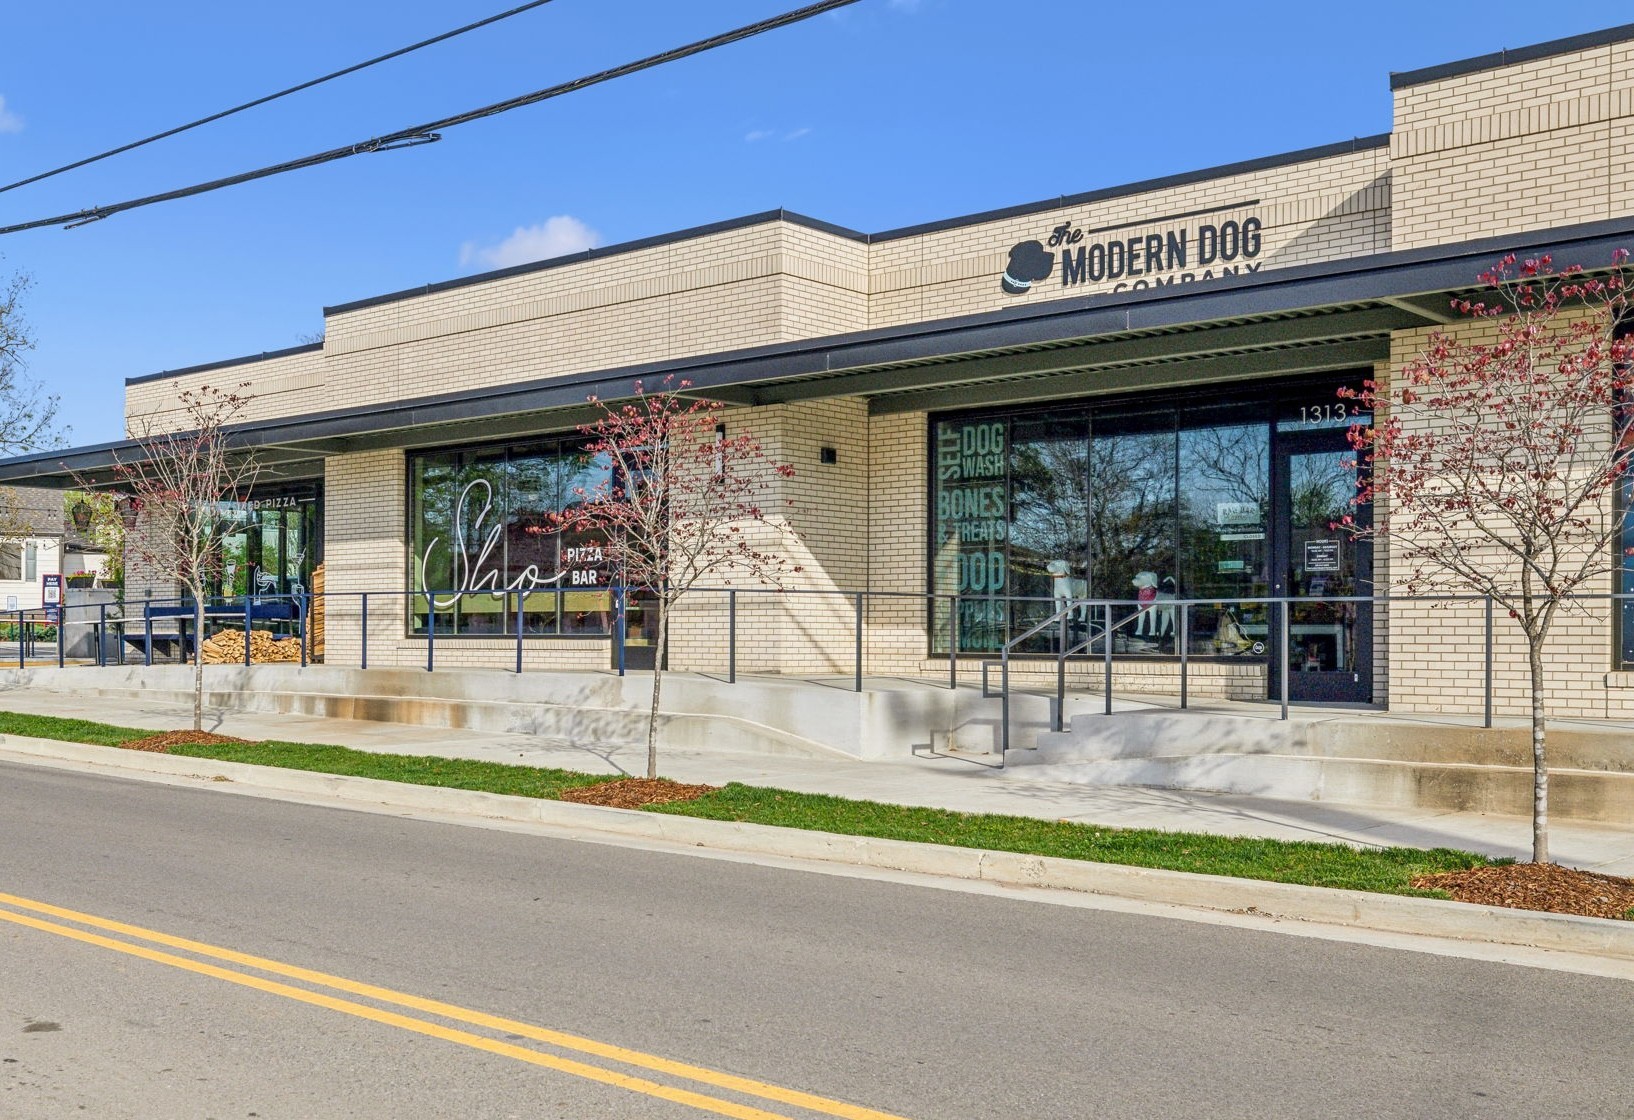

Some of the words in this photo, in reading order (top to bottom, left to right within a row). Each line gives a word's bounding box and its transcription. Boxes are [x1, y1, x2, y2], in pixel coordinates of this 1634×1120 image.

[1048, 221, 1083, 247] The
[1062, 229, 1187, 286] MODERN
[1199, 217, 1262, 265] DOG
[1300, 403, 1346, 424] 1313
[962, 423, 1004, 456] DOG
[938, 429, 960, 480] SELF
[962, 454, 1004, 478] WASH
[266, 497, 296, 509] PIZZA
[938, 486, 1005, 520] BONES
[423, 479, 566, 607] Sho
[953, 520, 1005, 543] TREATS
[567, 548, 602, 562] PIZZA
[572, 570, 597, 585] BAR
